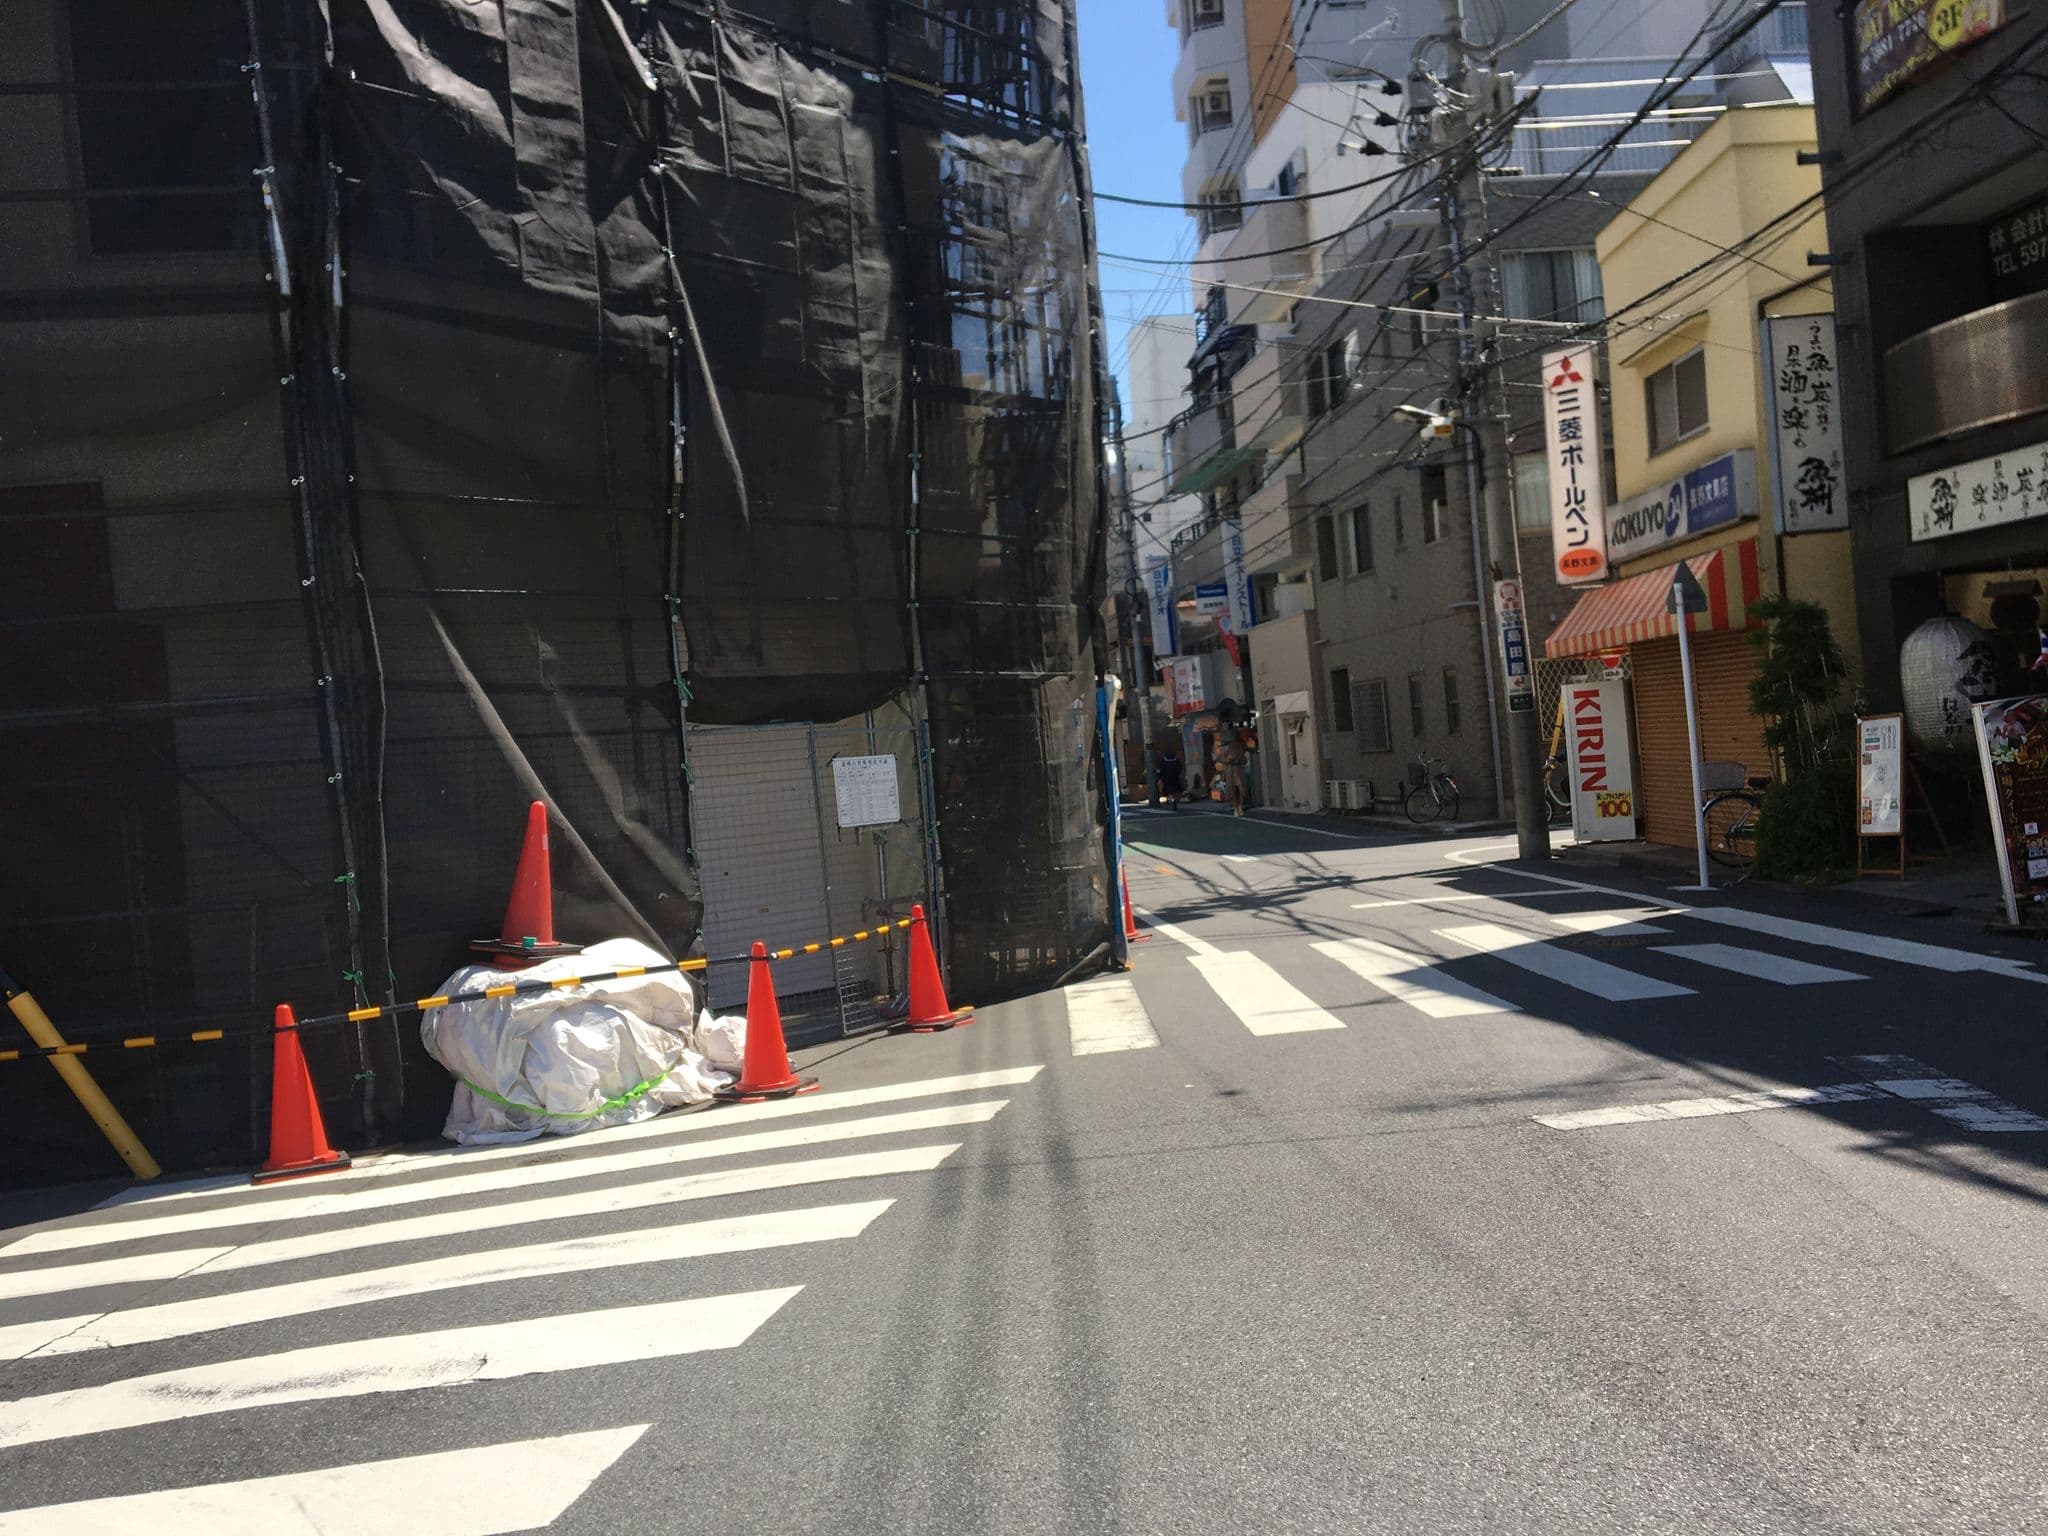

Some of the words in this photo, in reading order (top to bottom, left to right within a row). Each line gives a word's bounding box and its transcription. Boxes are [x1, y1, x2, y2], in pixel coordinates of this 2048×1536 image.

[1991, 251, 2018, 277] TEL
[1611, 501, 1664, 546] KOKUYO
[1573, 689, 1608, 793] KIRIN
[1598, 799, 1632, 818] 100
